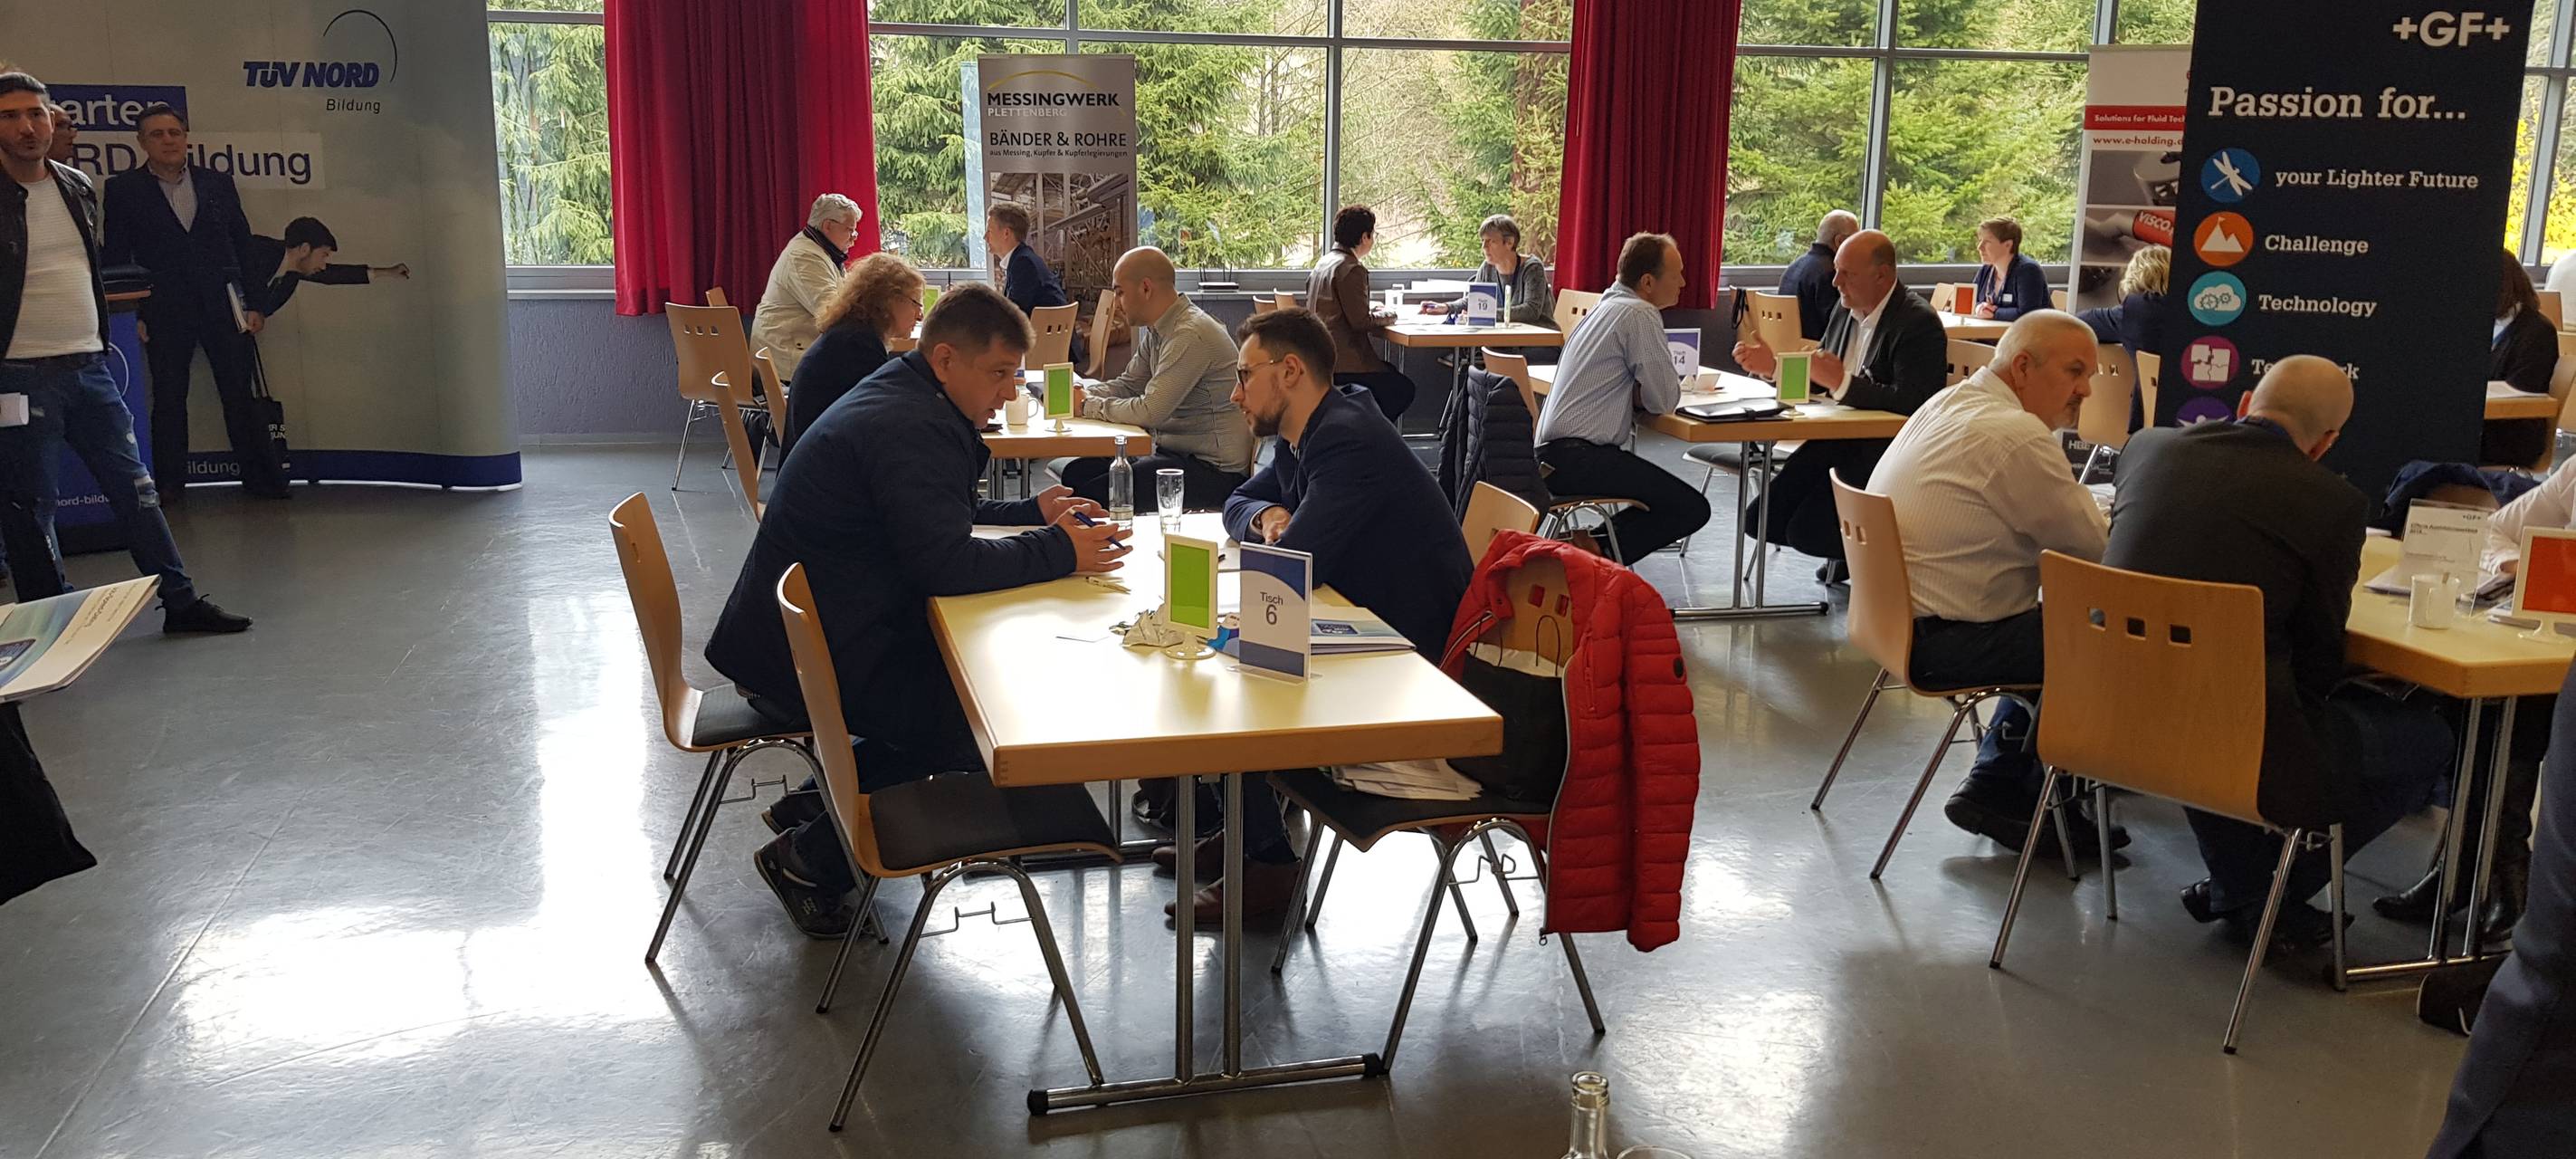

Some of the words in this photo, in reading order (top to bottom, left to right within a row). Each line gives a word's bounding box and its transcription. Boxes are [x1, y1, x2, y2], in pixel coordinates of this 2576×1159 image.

[2392, 11, 2510, 47] +GF+
[301, 61, 380, 88] NORD
[326, 98, 381, 114] Bildung
[987, 92, 1121, 106] MESSINGWERK
[2208, 86, 2363, 118] Passion
[2377, 87, 2466, 120] for...
[58, 94, 169, 126] arte
[987, 107, 1067, 117] PLETTENBERG
[2094, 113, 2132, 123] Solutions
[2132, 114, 2145, 123] for
[2147, 114, 2168, 123] Fluid
[989, 129, 1053, 147] BÄNDER
[1056, 131, 1070, 146] &
[1074, 132, 1128, 147] ROHRE
[1003, 148, 1033, 158] Messing,
[1034, 149, 1056, 158] Kupfer
[1057, 148, 1064, 158] &
[72, 143, 138, 176] RD
[186, 143, 311, 186] ildung
[2275, 169, 2323, 188] your
[2326, 168, 2403, 189] Lighter
[2408, 170, 2479, 189] Future
[2265, 235, 2370, 257] Challenge
[2257, 293, 2378, 318] Technology
[1674, 355, 1686, 364] 14
[186, 461, 241, 476] ildung
[1259, 591, 1283, 606] Tisch
[1265, 604, 1277, 626] 6
